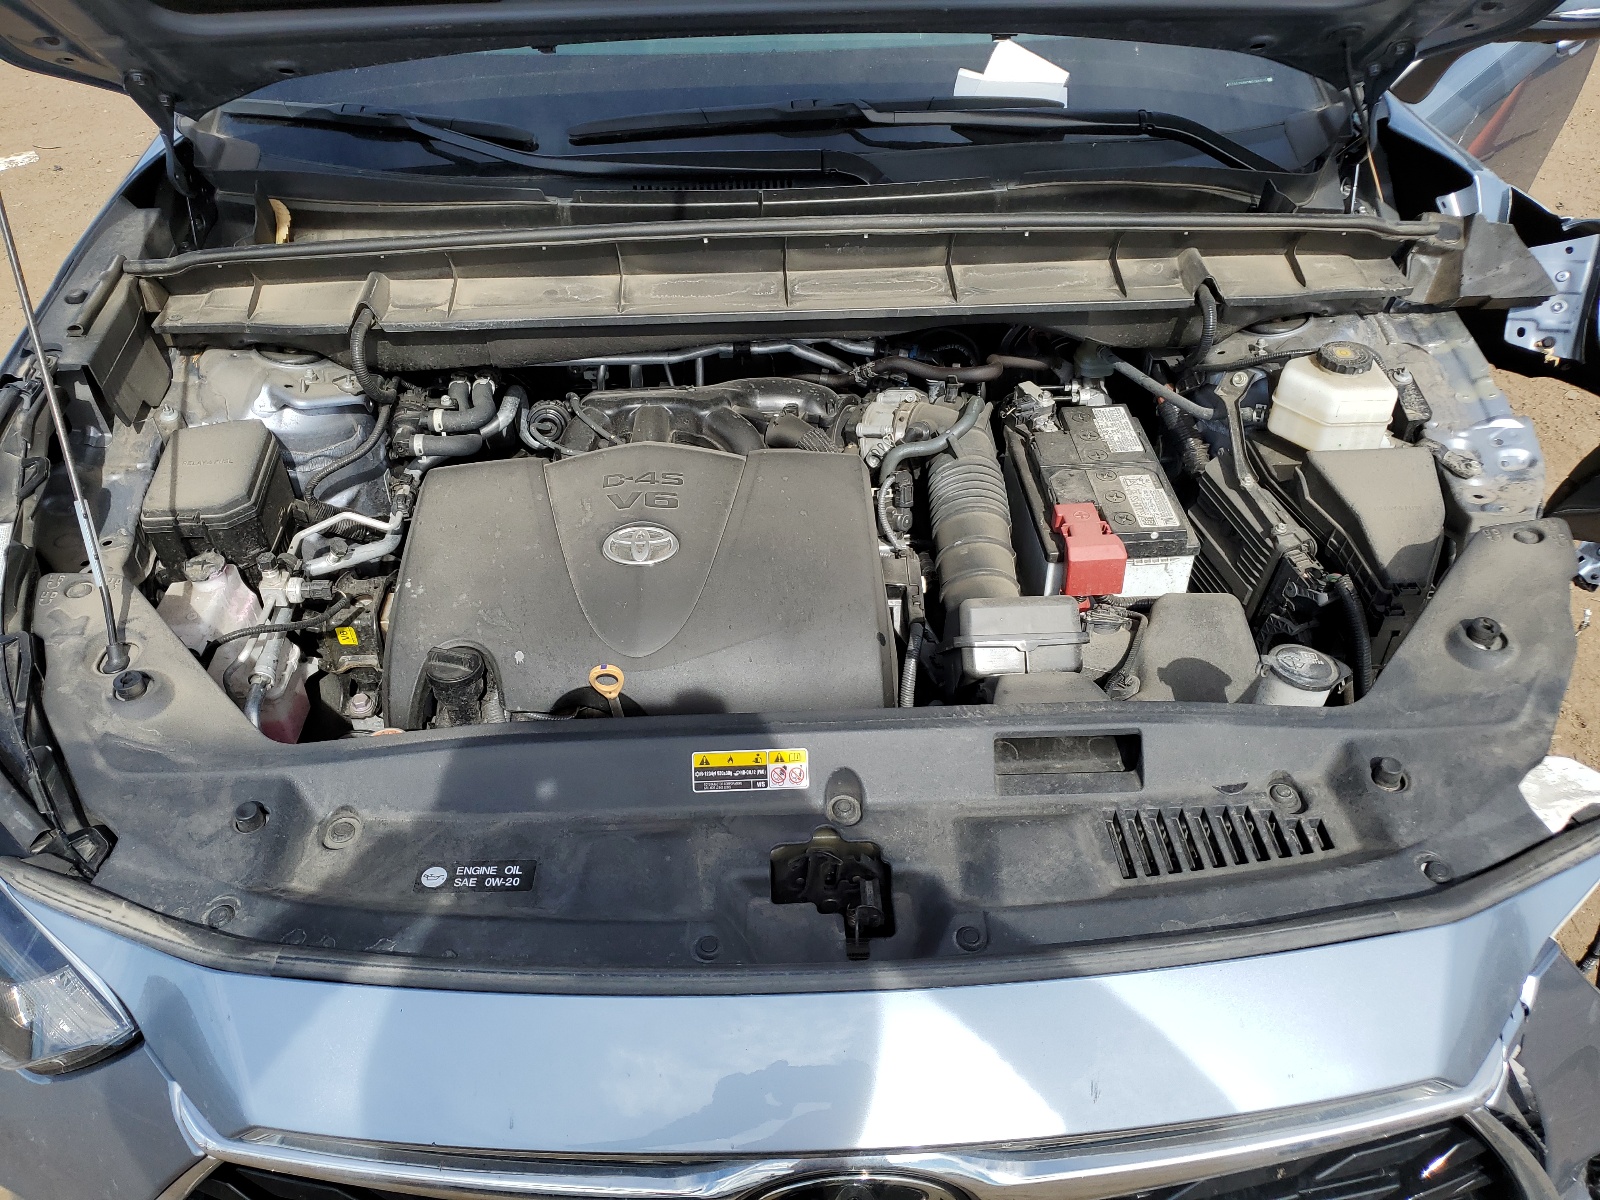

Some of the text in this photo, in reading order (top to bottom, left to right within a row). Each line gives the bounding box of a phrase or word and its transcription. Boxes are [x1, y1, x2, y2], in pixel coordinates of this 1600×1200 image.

[607, 491, 679, 510] V6
[456, 865, 523, 875] ENGINE OIL
[453, 877, 520, 887] SAE 0W-20
